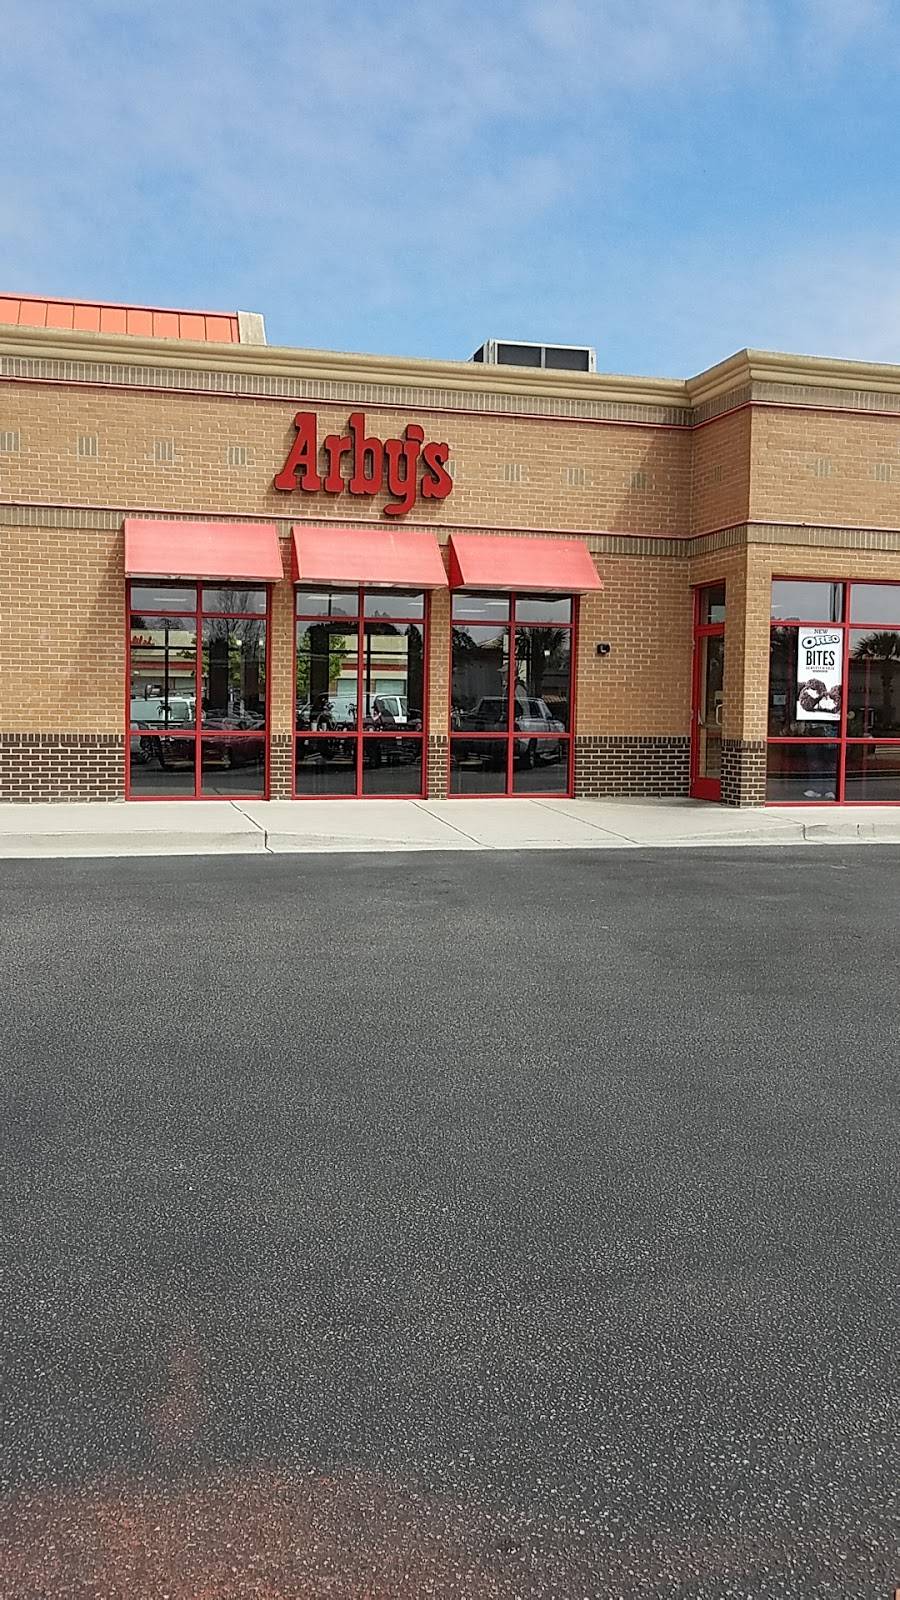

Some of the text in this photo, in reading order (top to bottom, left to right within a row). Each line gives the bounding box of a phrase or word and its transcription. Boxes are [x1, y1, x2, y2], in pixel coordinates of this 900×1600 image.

[274, 412, 453, 516] Arby's
[802, 635, 840, 649] OREO
[806, 650, 835, 666] BITES
